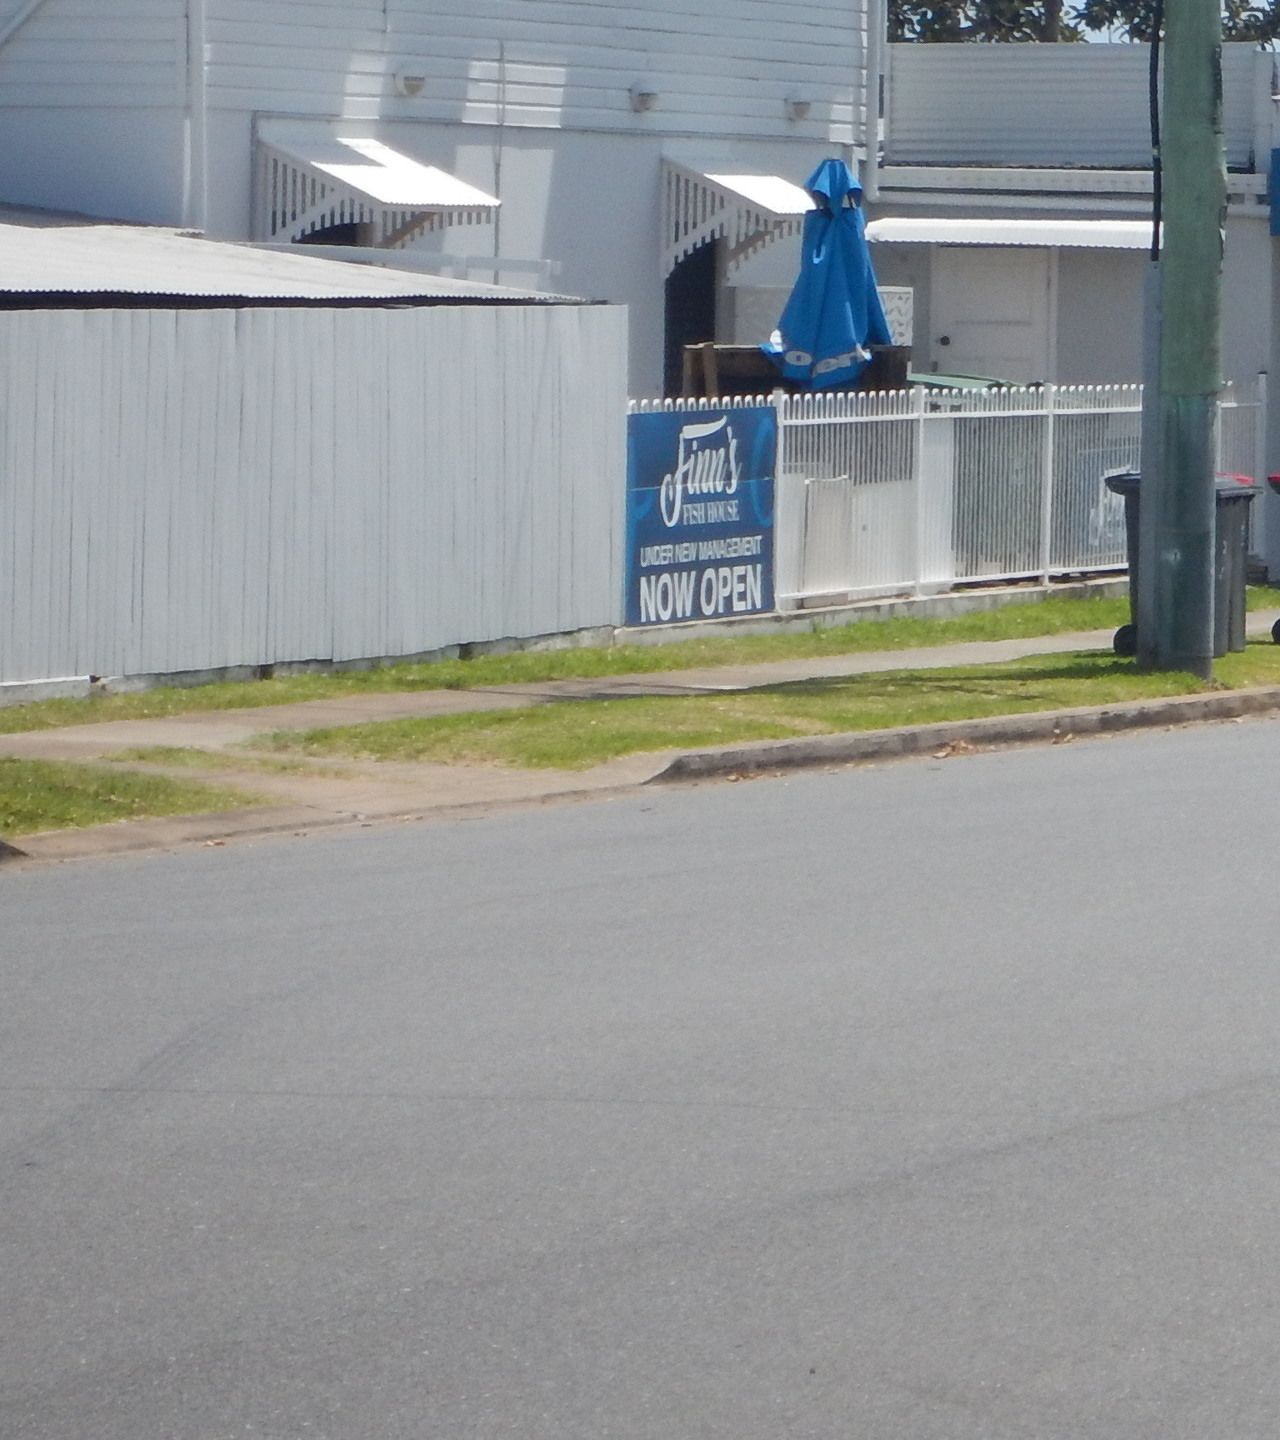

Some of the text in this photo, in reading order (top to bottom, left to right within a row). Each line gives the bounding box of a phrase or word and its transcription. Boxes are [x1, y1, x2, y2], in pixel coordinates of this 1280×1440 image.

[660, 415, 742, 528] Finn's
[683, 500, 740, 525] FISH HOUSE
[640, 535, 762, 567] UNDER NEW MANAGEMENT
[640, 563, 762, 623] NOW OPEN
